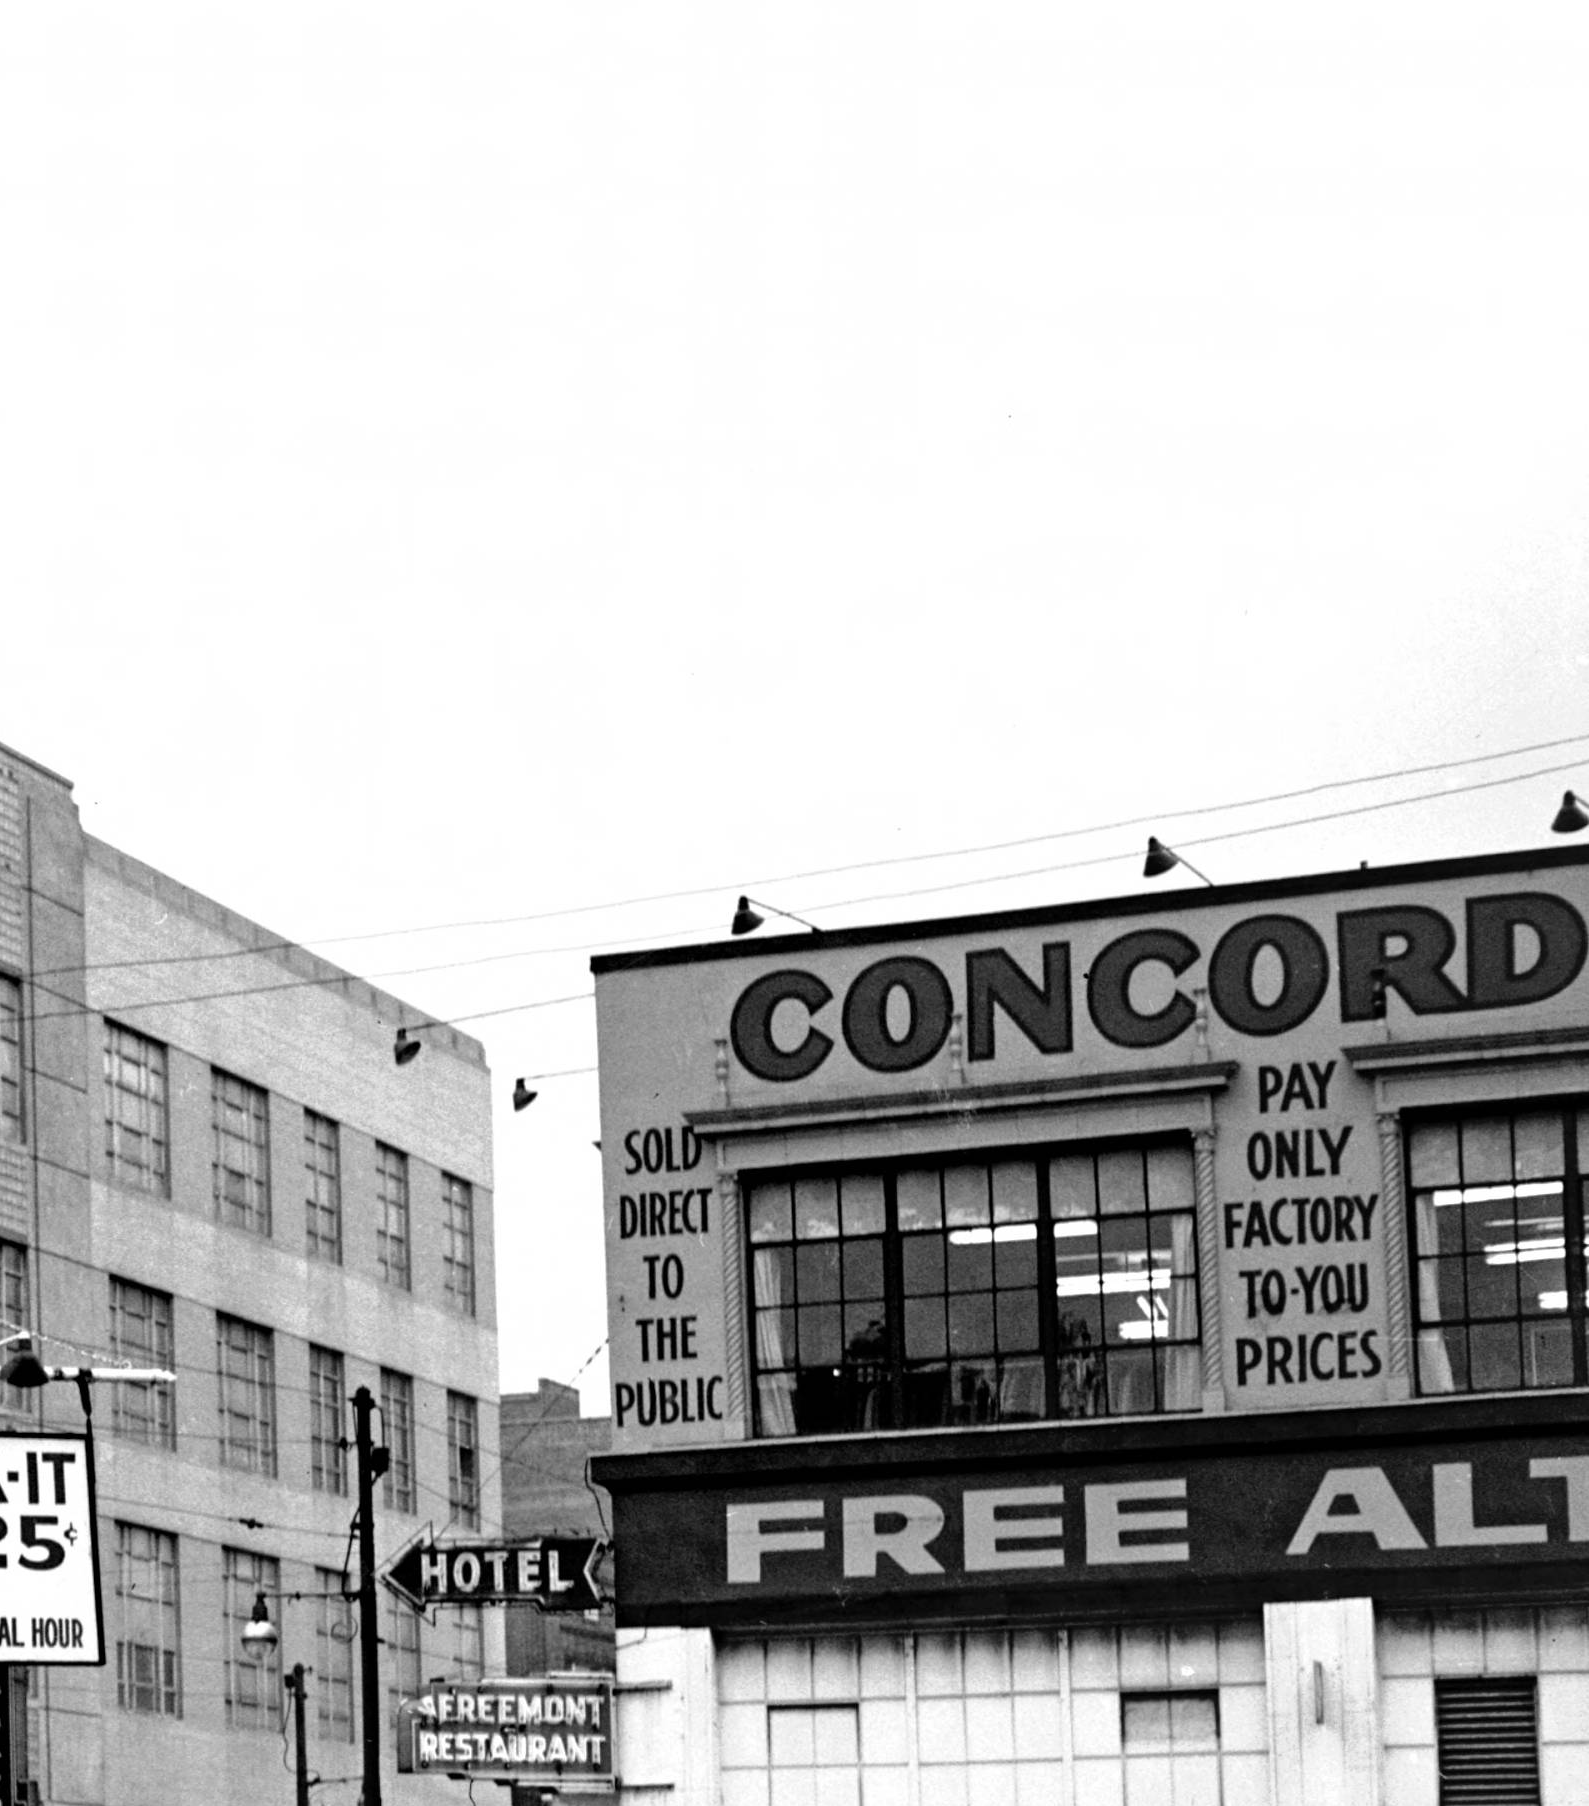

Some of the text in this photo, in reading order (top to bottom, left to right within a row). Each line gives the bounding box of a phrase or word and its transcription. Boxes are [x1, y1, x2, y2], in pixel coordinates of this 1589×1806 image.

[729, 890, 1588, 1084] CONCORD
[1257, 1060, 1337, 1114] PAY
[624, 1125, 703, 1176] SOLD
[1246, 1125, 1354, 1182] ONLY
[619, 1187, 713, 1240] DIRECT
[1223, 1193, 1379, 1249] FACTORY
[642, 1253, 685, 1300] TO
[1238, 1262, 1370, 1319] TO-YOU
[635, 1314, 698, 1363] THE
[1235, 1329, 1382, 1387] PRICES
[615, 1375, 723, 1428] PUBLIC
[726, 1456, 1589, 1584] FREE ALT
[420, 1550, 574, 1594] HOTEL
[31, 1617, 84, 1649] HOUR
[420, 1731, 606, 1764] RESTAURANT
